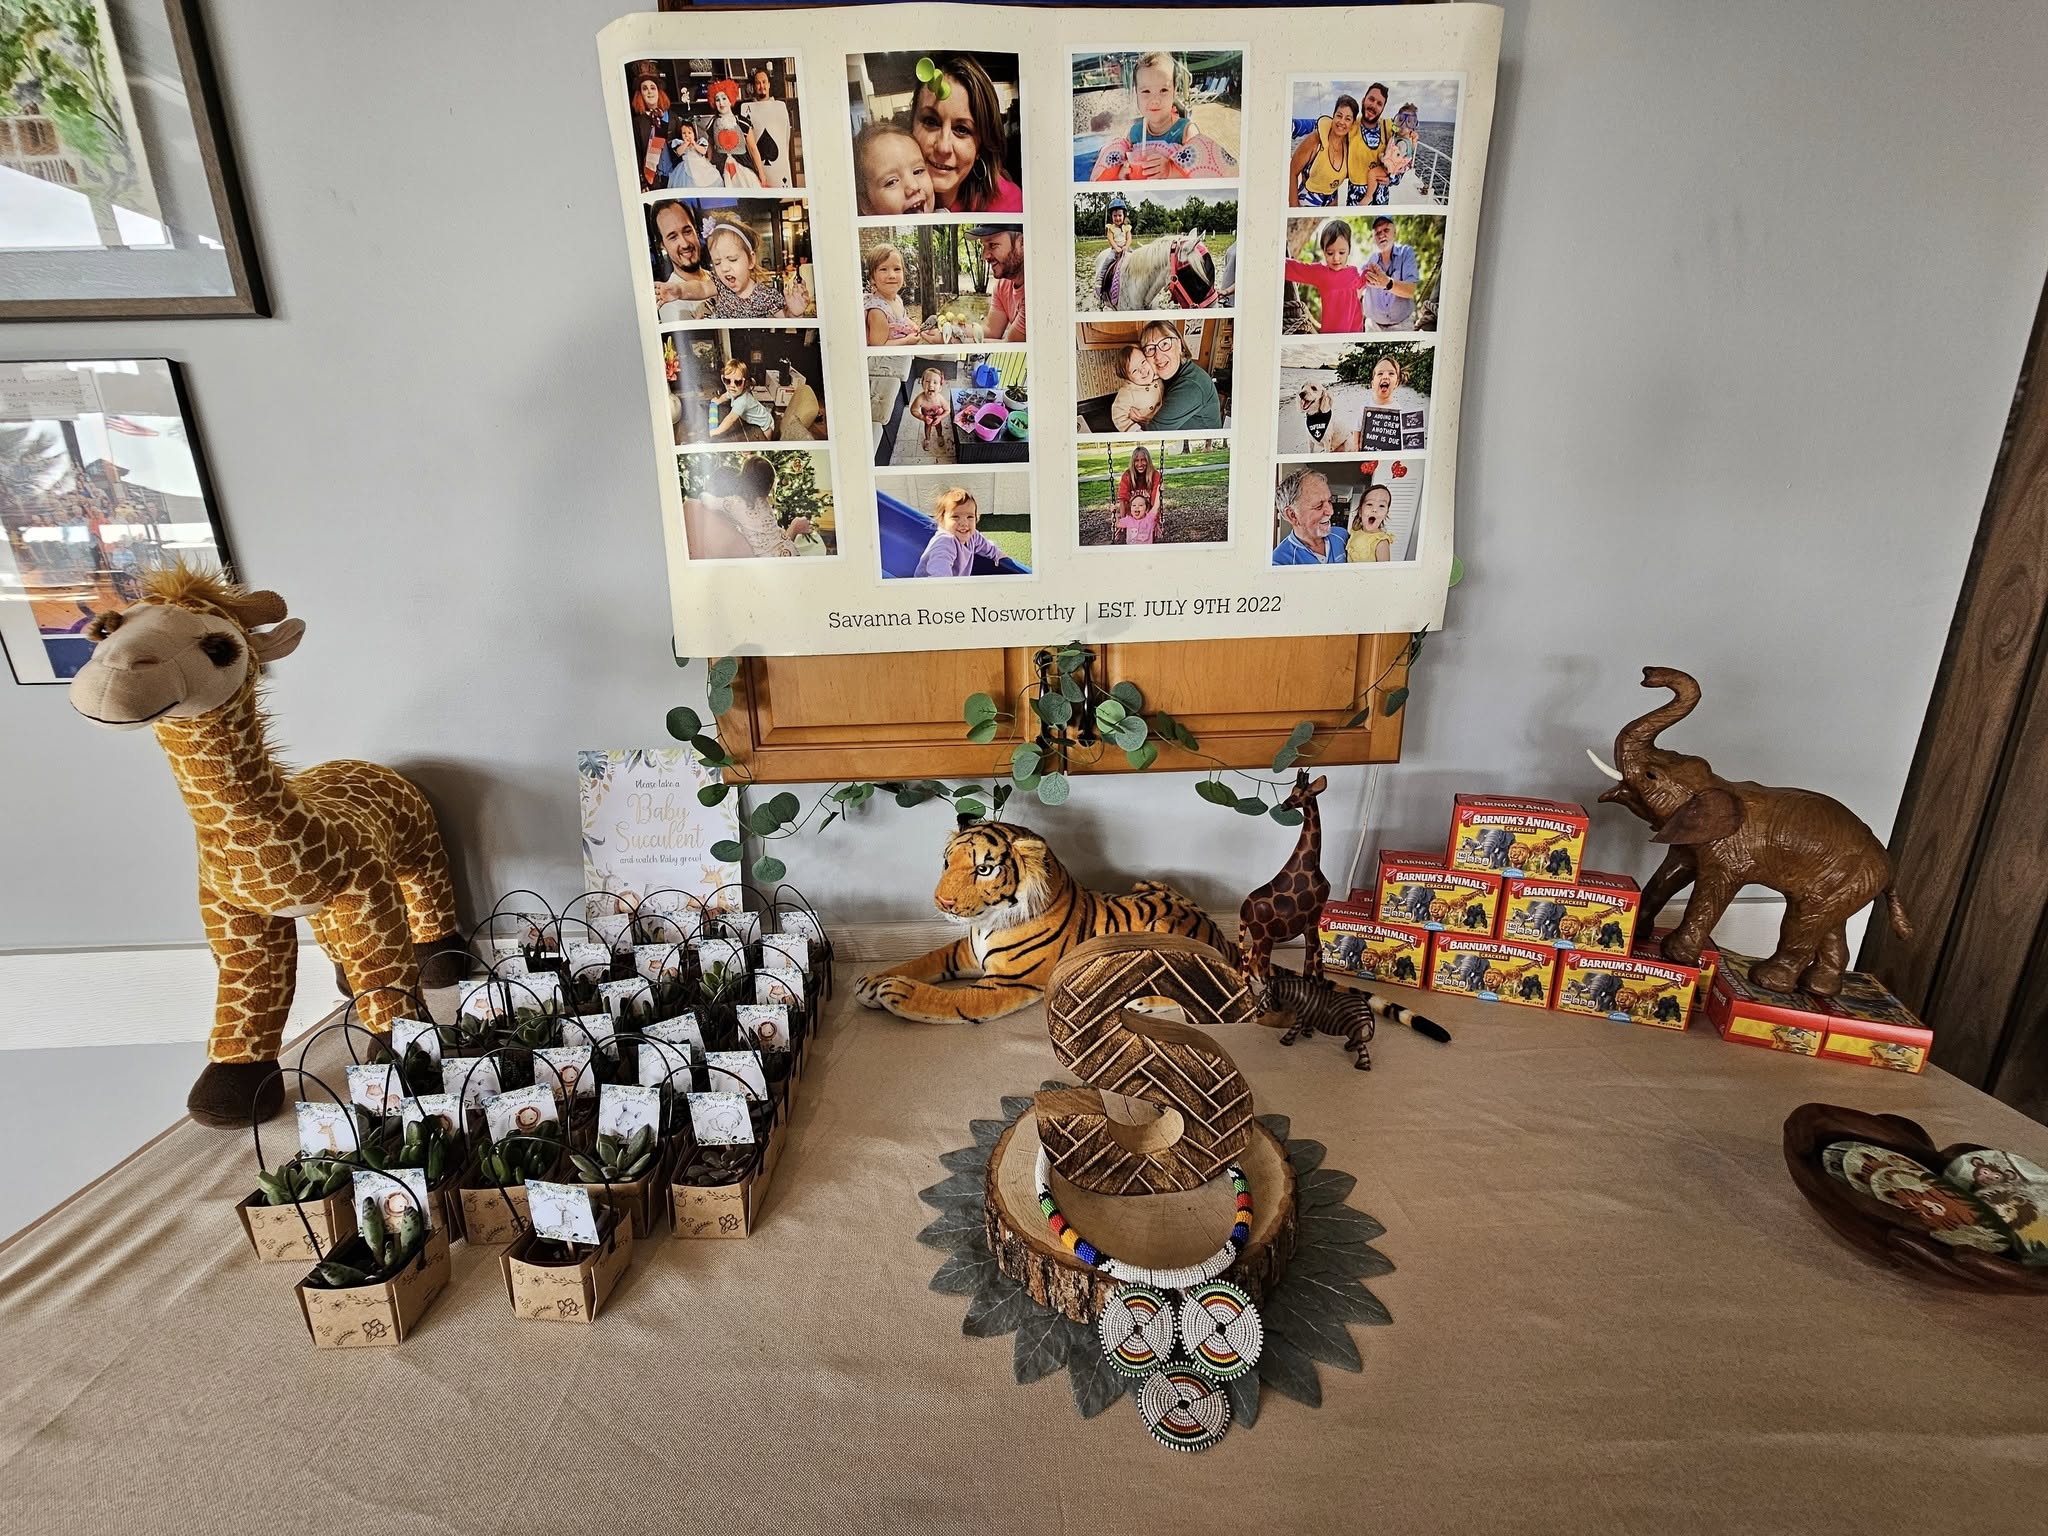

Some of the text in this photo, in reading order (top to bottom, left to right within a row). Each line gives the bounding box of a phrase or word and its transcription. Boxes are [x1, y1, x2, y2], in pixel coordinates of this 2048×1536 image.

[1372, 427, 1396, 436] ANOTHER
[829, 596, 1282, 628] Savanna Rose Nosworthy EST. JULY 9TH 2022
[627, 793, 691, 831] Baby
[1474, 801, 1524, 810] BARNUM'S
[1472, 814, 1574, 834] BARNUM'S ANIMALS
[616, 820, 705, 852] Succulent
[1396, 872, 1487, 890] BARNUM'S ANIMALS
[1523, 887, 1624, 908] BARNUM'S ANIMALS
[1330, 922, 1373, 934] BARNUM'S
[1374, 926, 1414, 943] ANIMALS
[1450, 940, 1543, 962] BARNUM'S ANIMALS
[1580, 958, 1682, 982] BARNUM'S ANIMALS
[1614, 972, 1644, 980] CRACKERS
